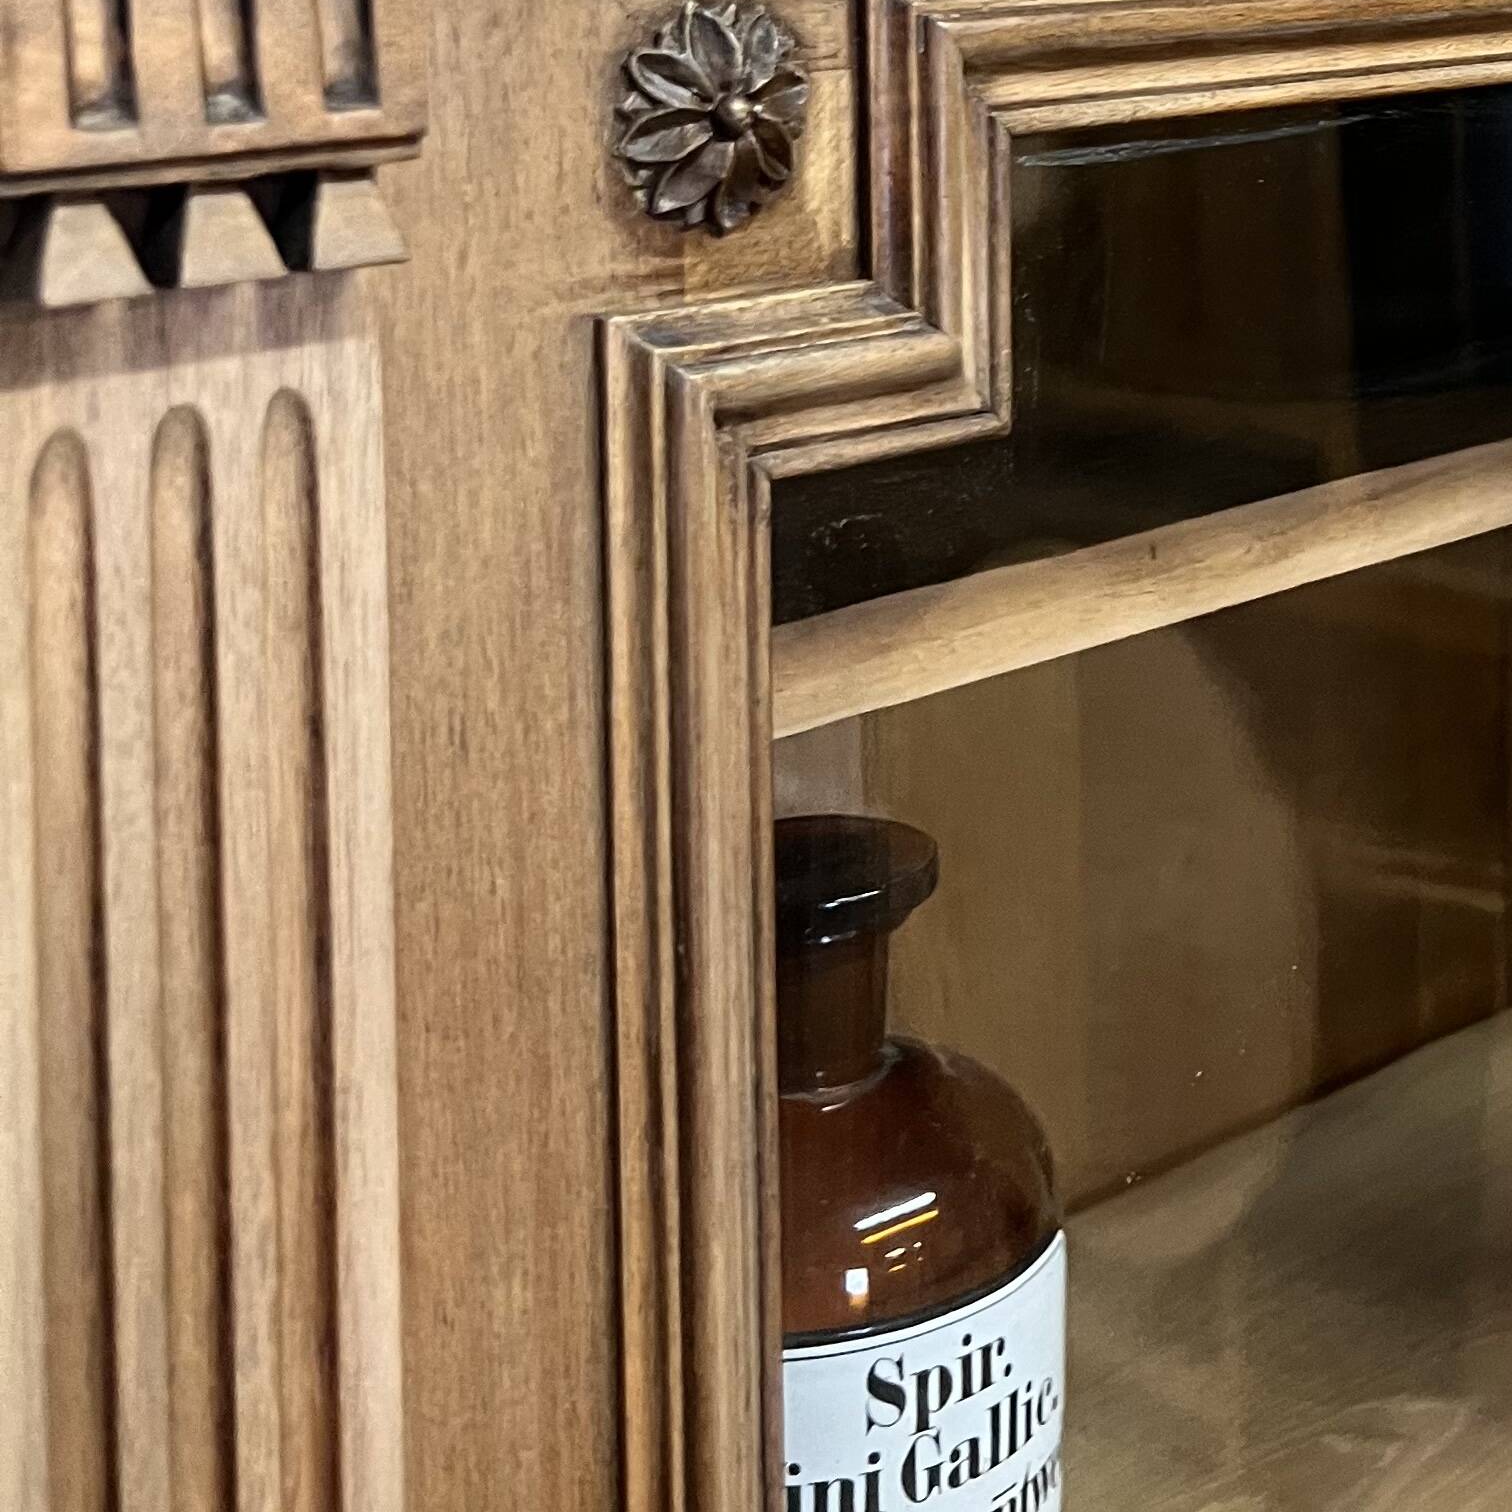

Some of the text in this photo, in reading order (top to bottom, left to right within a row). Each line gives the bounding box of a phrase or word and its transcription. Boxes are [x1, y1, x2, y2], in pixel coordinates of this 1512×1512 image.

[784, 1451, 885, 1512] ini
[900, 1376, 1058, 1503] Gallic.
[865, 1333, 1012, 1436] Spir.
